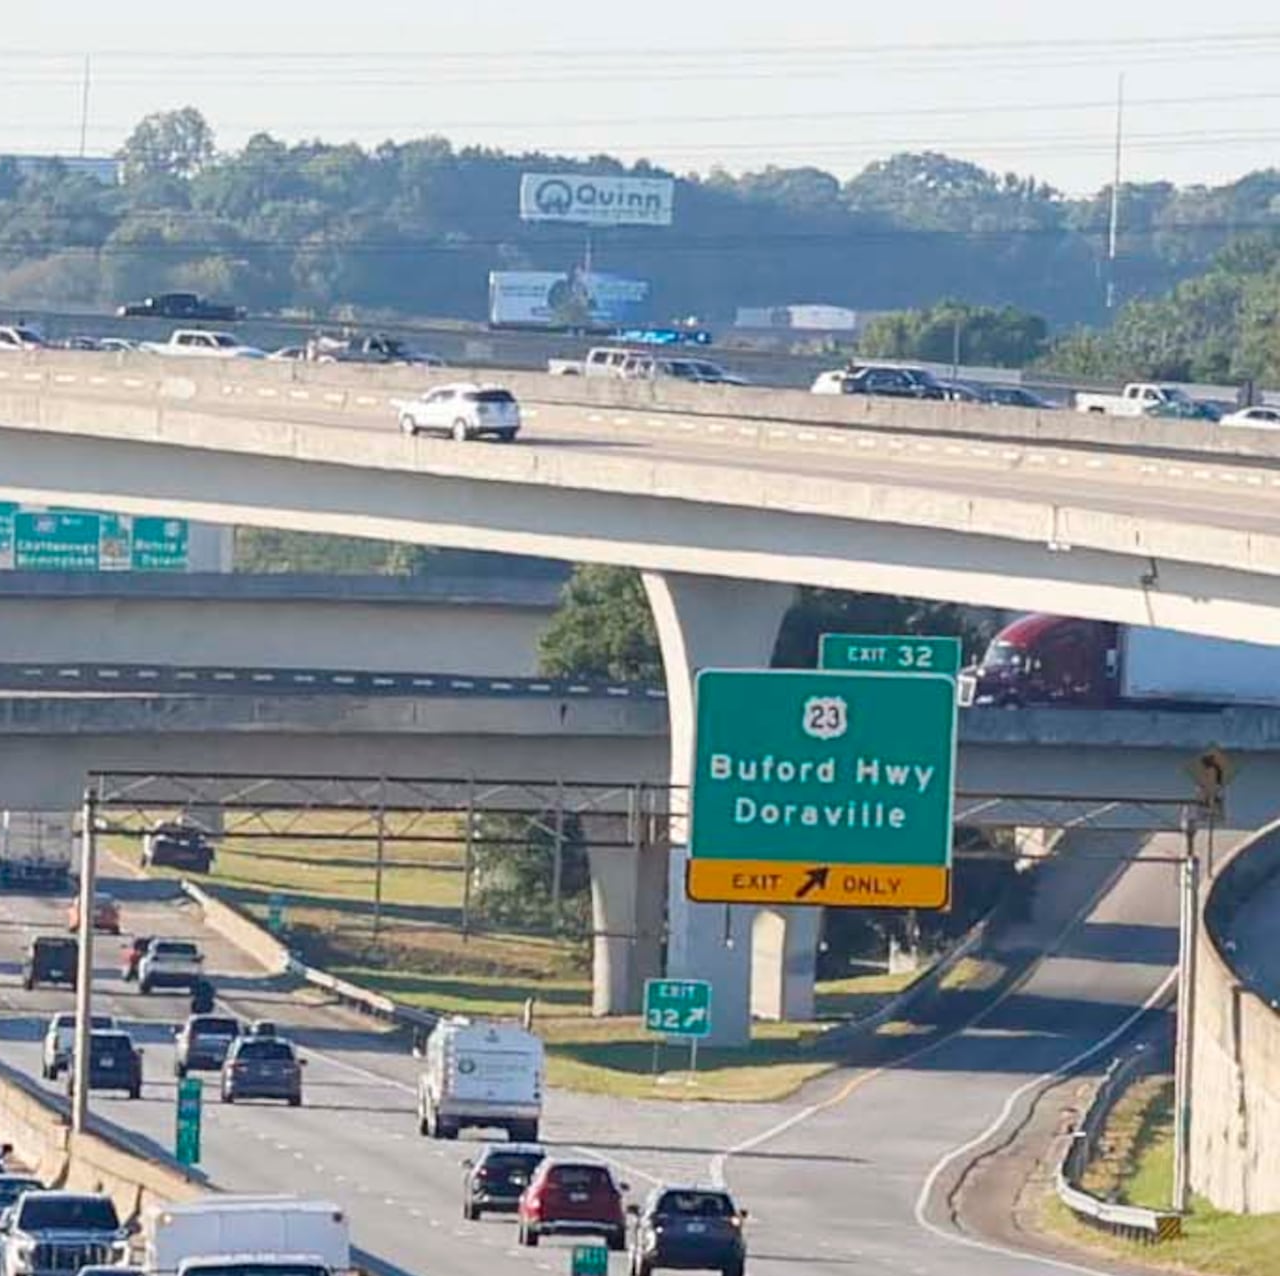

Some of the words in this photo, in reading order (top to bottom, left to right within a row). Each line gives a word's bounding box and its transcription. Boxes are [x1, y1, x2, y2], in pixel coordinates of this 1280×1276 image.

[577, 184, 661, 207] Quinn
[847, 646, 887, 662] EXIT
[898, 646, 933, 667] 32
[809, 705, 840, 730] 23
[710, 754, 835, 783] Buford
[856, 758, 935, 792] Hwy
[734, 797, 907, 828] Doraville
[732, 873, 782, 890] EXIT
[842, 876, 901, 895] ONLY
[659, 984, 695, 999] EXIT
[648, 1007, 680, 1028] 32
